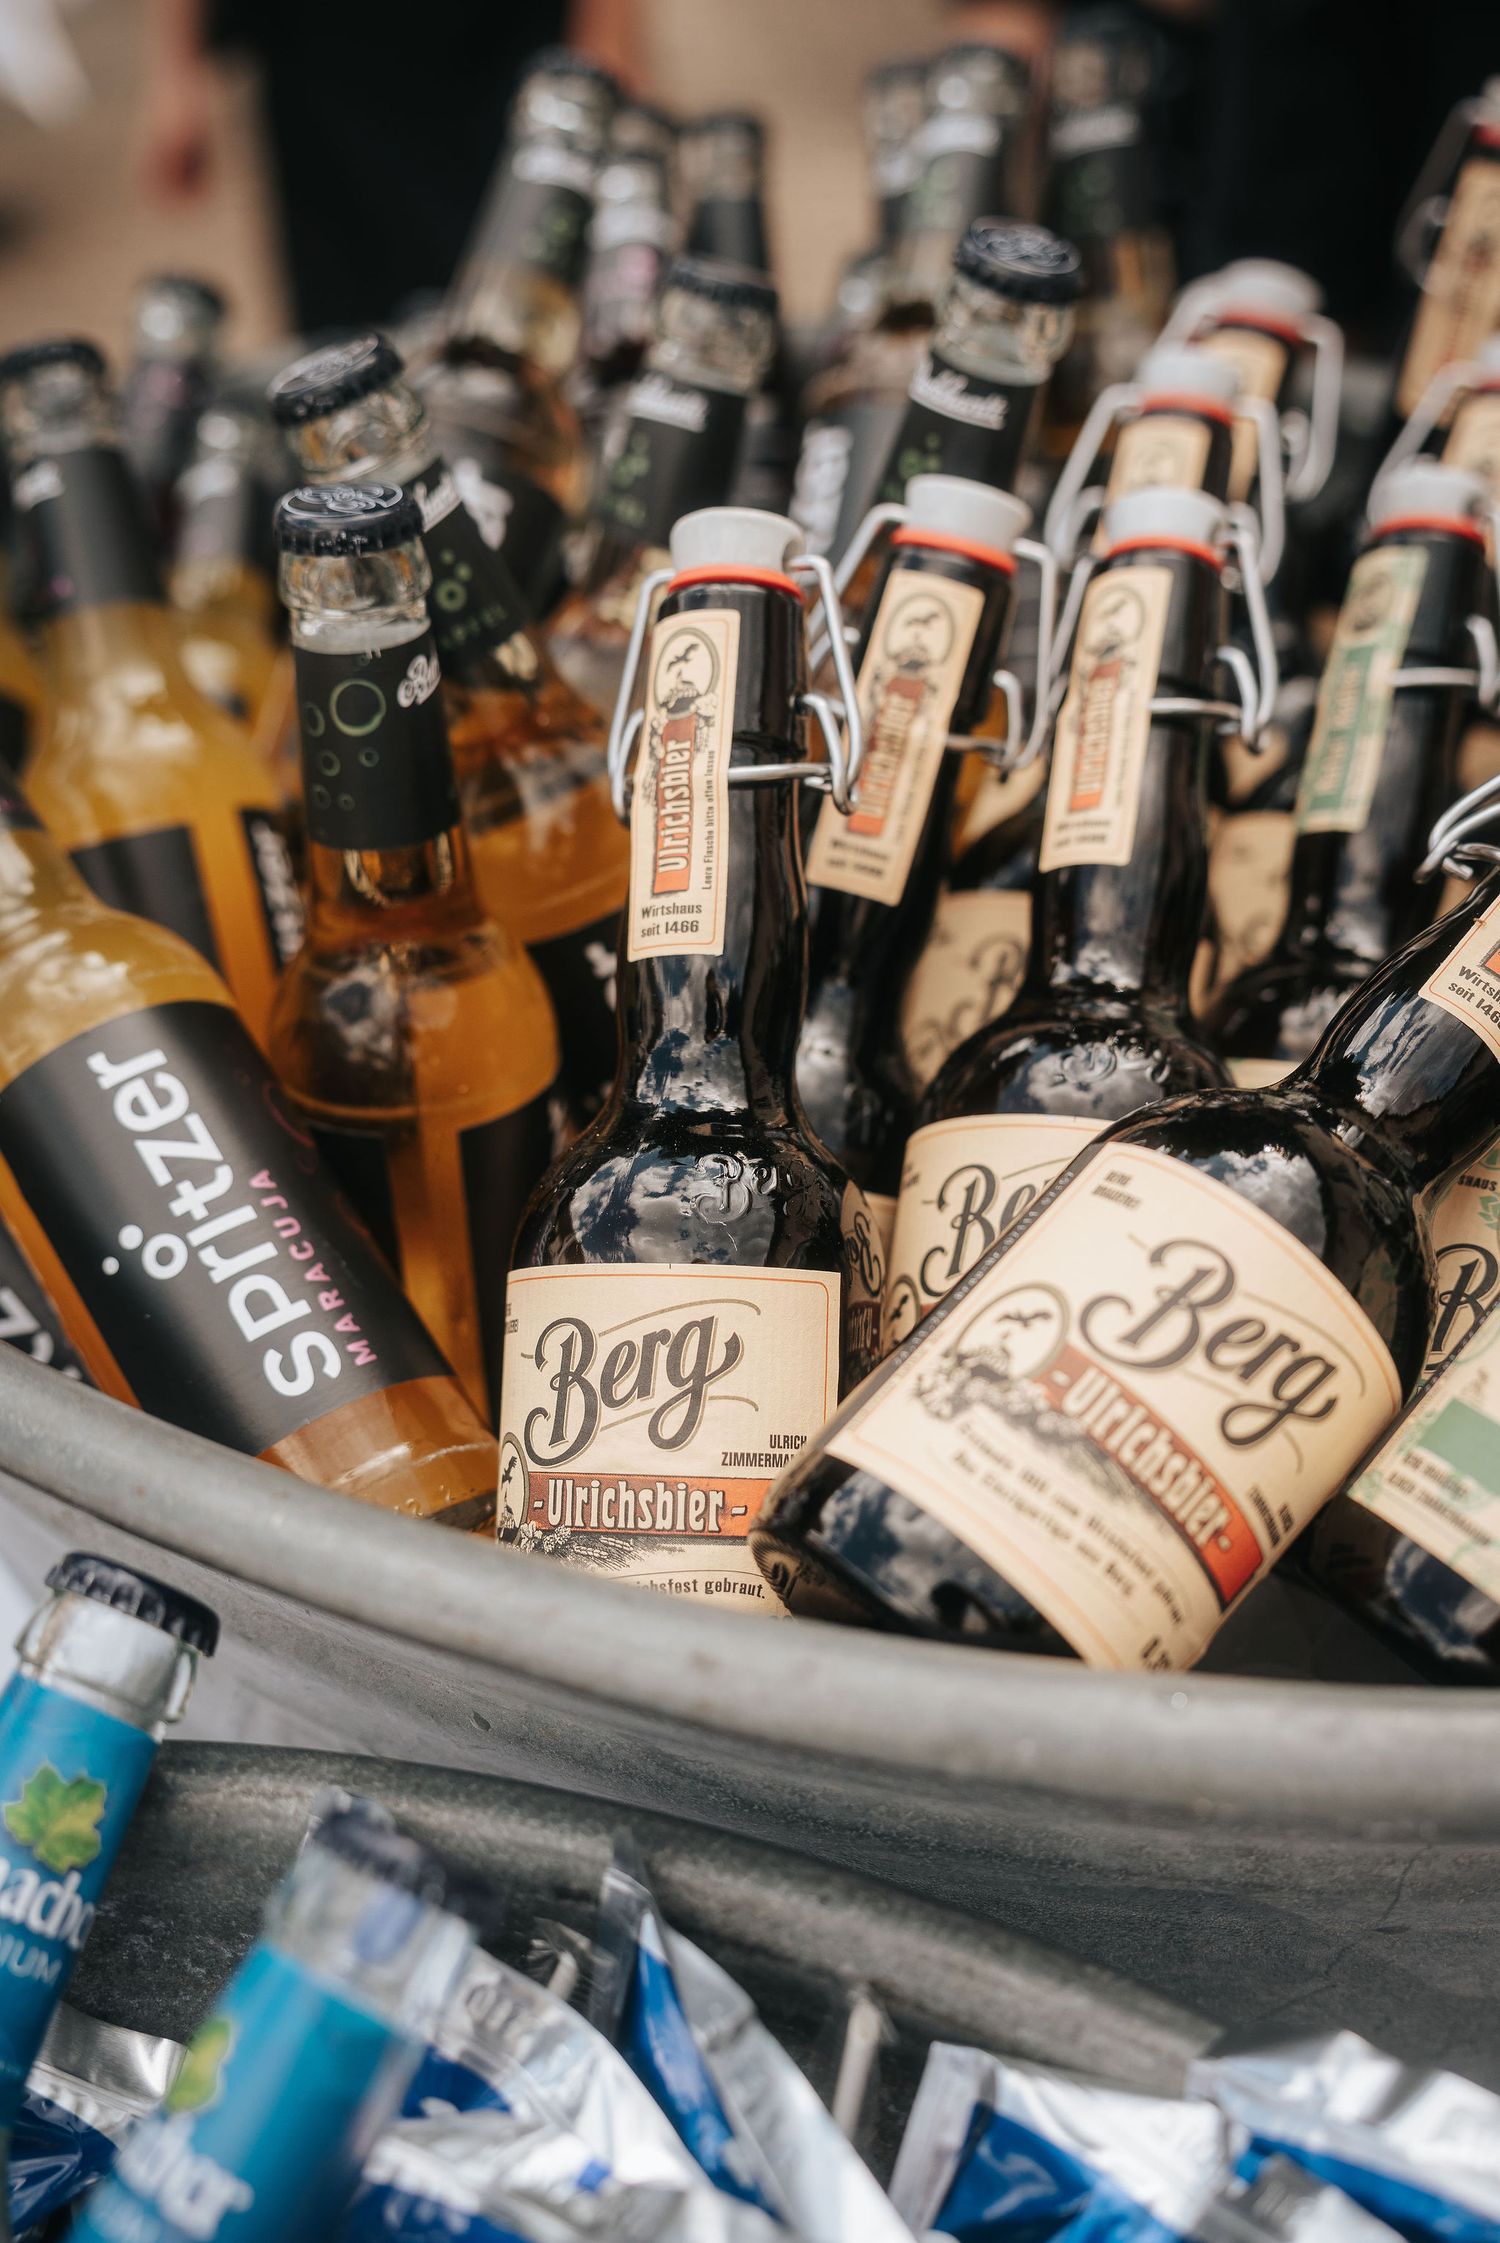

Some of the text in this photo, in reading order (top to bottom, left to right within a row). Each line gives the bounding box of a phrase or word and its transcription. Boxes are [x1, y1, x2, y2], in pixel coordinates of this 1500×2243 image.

[658, 739, 692, 873] Ulrichsbier
[641, 902, 703, 919] Wirtshaus
[641, 919, 700, 938] seit 1466
[1448, 982, 1500, 1031] seit 146
[1457, 1174, 1498, 1192] SHAUS
[250, 1169, 377, 1367] MARACUJA
[1079, 1239, 1339, 1448] Berg
[524, 1315, 745, 1468] Berg
[721, 1451, 795, 1468] ZIMMERMA
[704, 1577, 766, 1600] gebraut.
